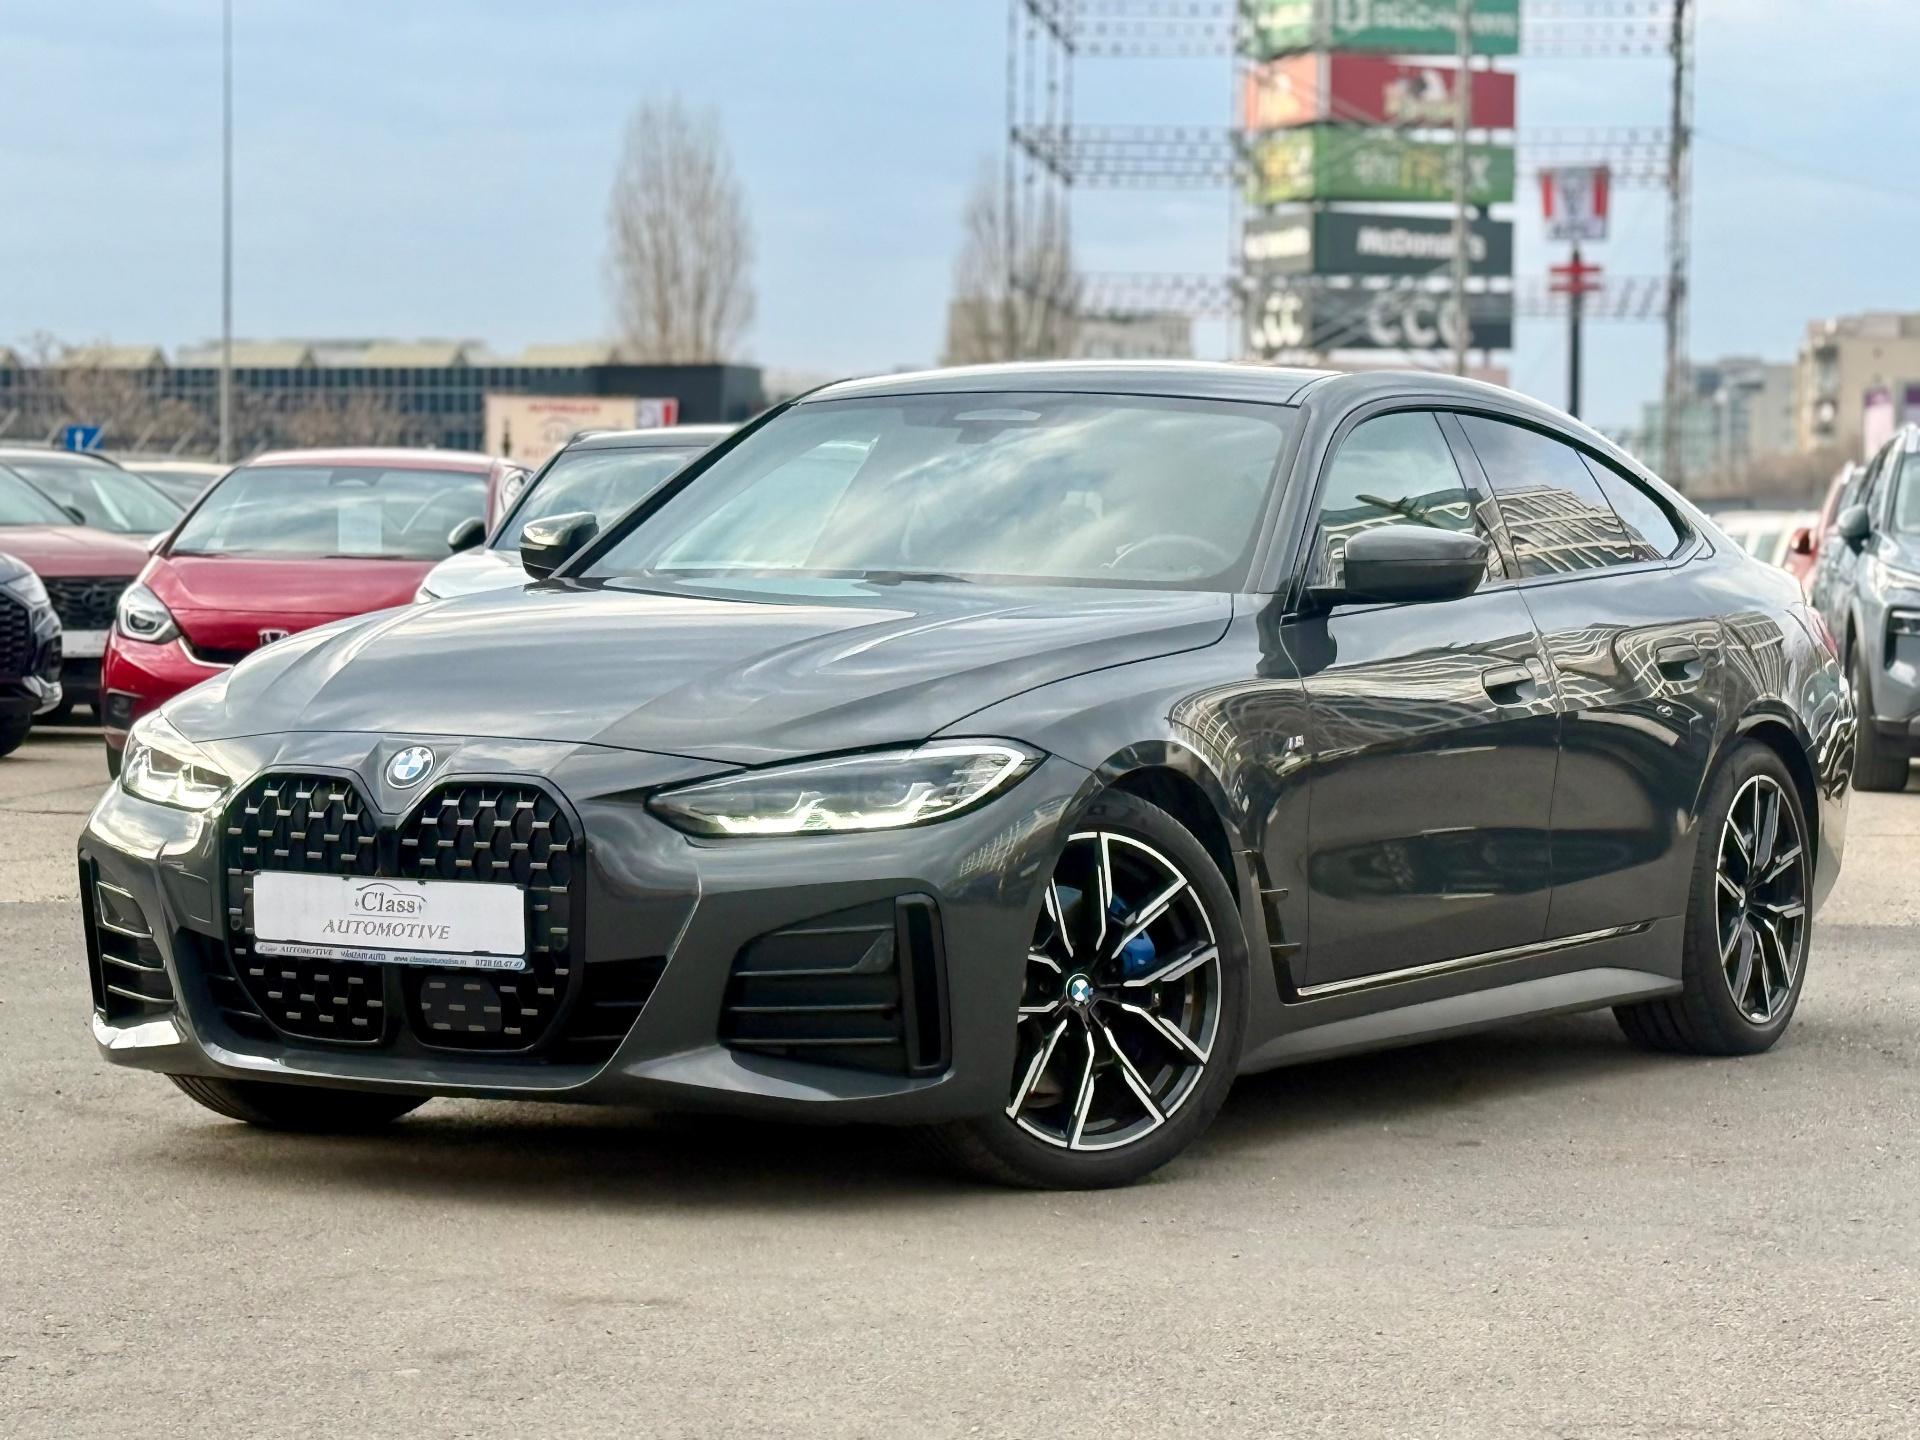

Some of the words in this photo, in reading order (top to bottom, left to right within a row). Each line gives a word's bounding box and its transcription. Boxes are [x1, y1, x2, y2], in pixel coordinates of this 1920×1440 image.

[361, 891, 415, 913] Class
[322, 919, 451, 940] AUTOMOTIVE
[280, 946, 333, 956] AUTOMOTIVE
